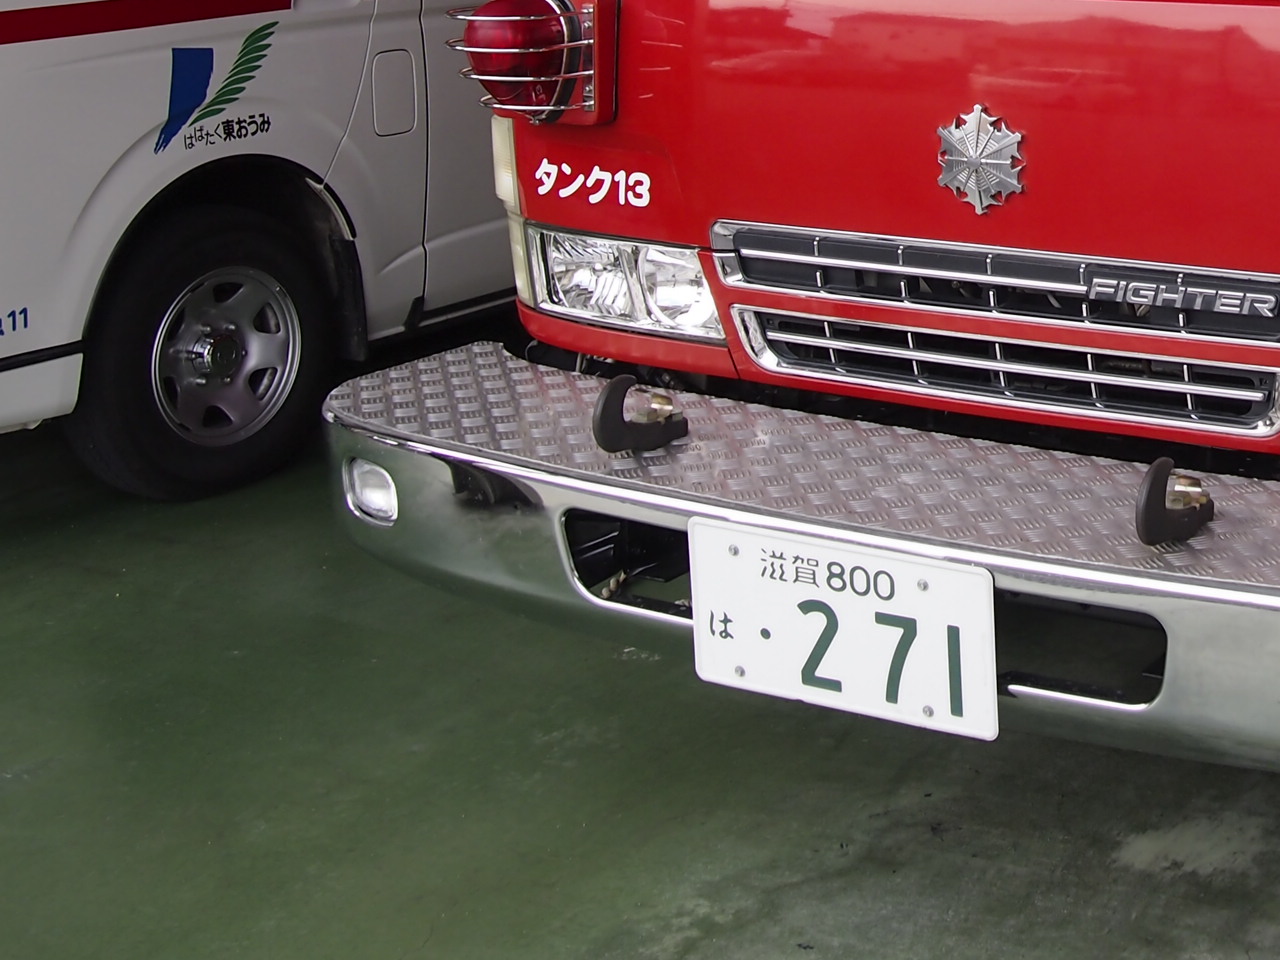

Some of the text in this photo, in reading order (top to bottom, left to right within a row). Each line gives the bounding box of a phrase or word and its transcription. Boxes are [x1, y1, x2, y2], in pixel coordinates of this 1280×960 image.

[184, 113, 271, 150] はばたく東おうみ
[535, 157, 651, 208] タンク13
[1089, 278, 1277, 317] FIGHTER
[0, 307, 28, 336] 11
